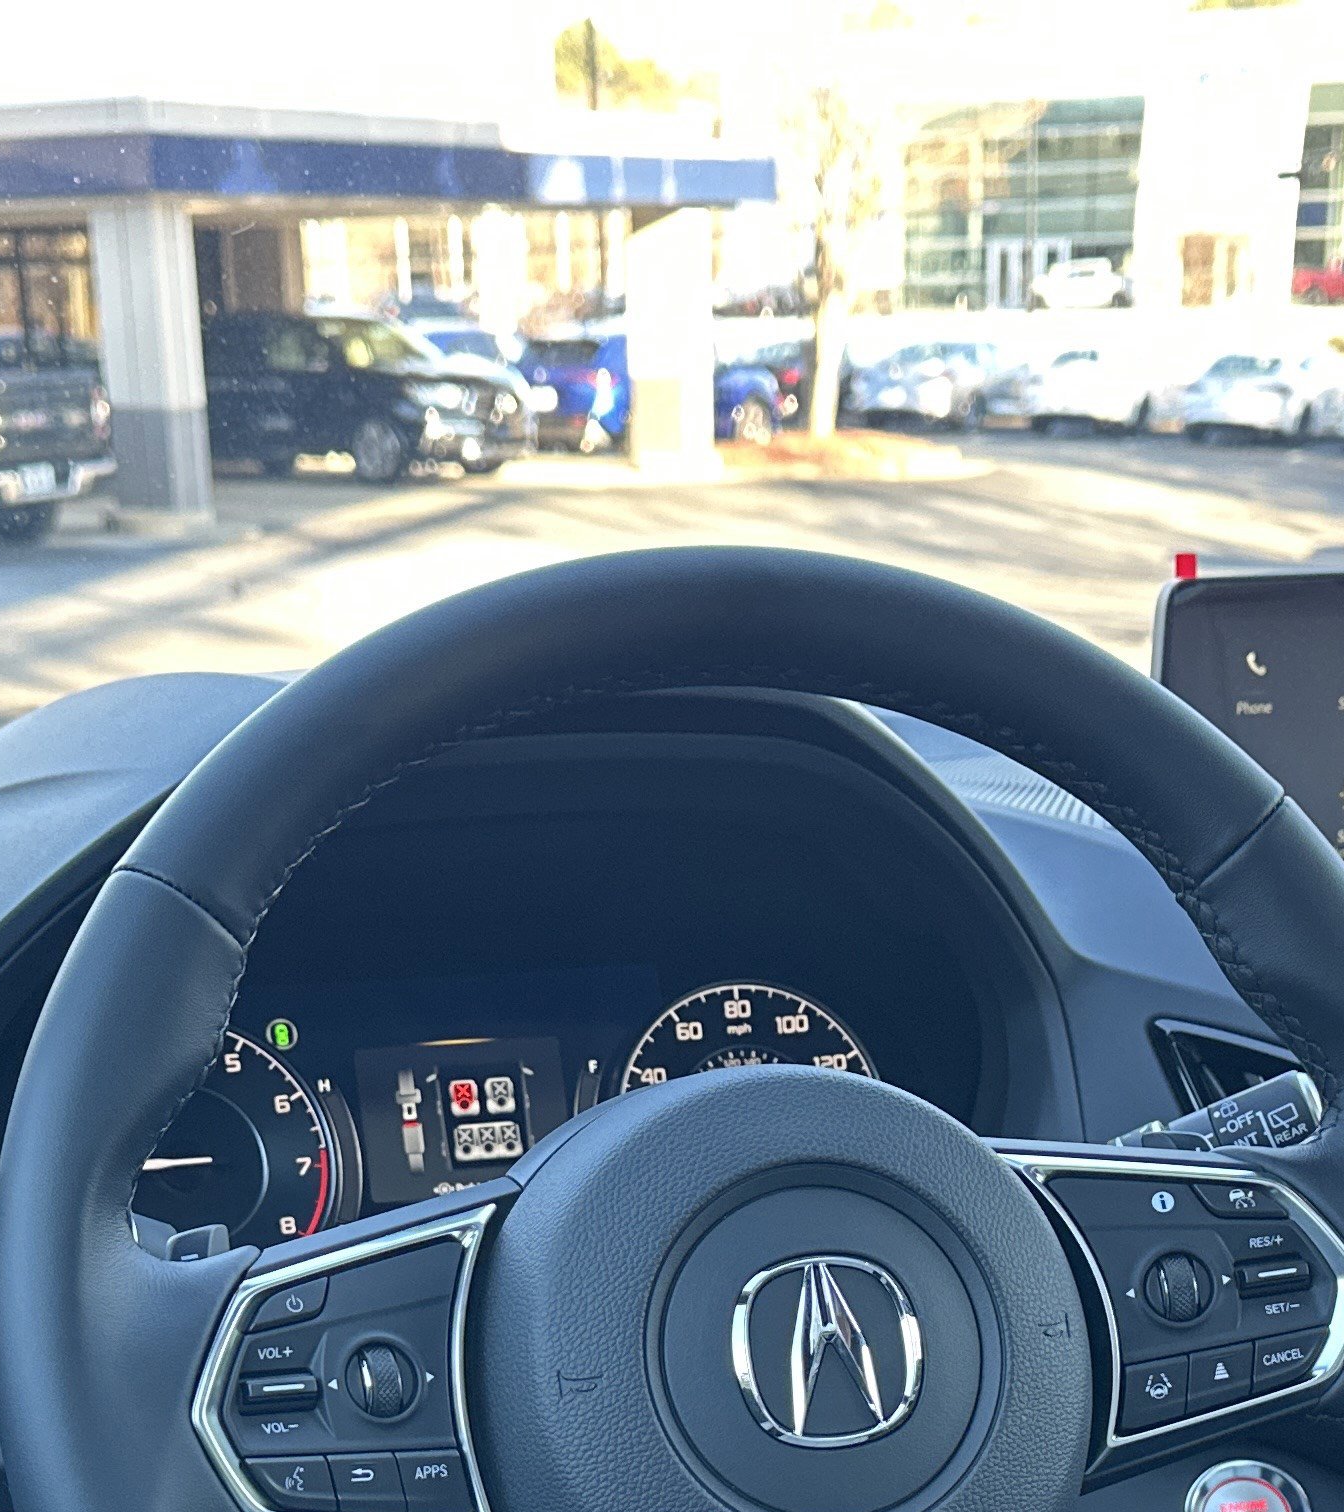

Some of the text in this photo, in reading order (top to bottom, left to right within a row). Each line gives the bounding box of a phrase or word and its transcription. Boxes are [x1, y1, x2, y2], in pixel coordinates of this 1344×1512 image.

[1236, 701, 1273, 715] Phone
[723, 999, 752, 1019] 80
[675, 1021, 704, 1042] 60
[726, 1023, 752, 1036] mph
[775, 1014, 809, 1035] 100
[224, 1053, 242, 1073] 5
[588, 1059, 598, 1074] F
[813, 1053, 848, 1071] 120
[640, 1067, 667, 1084] 40
[317, 1078, 331, 1093] H
[273, 1094, 291, 1114] 6
[1225, 1110, 1255, 1134] OFF
[1275, 1122, 1309, 1144] REAR
[295, 1156, 312, 1177] 7
[279, 1216, 296, 1235] 8
[257, 1345, 294, 1361] VOL+
[1262, 1347, 1305, 1367] CANCEL
[414, 1463, 449, 1481] APPS
